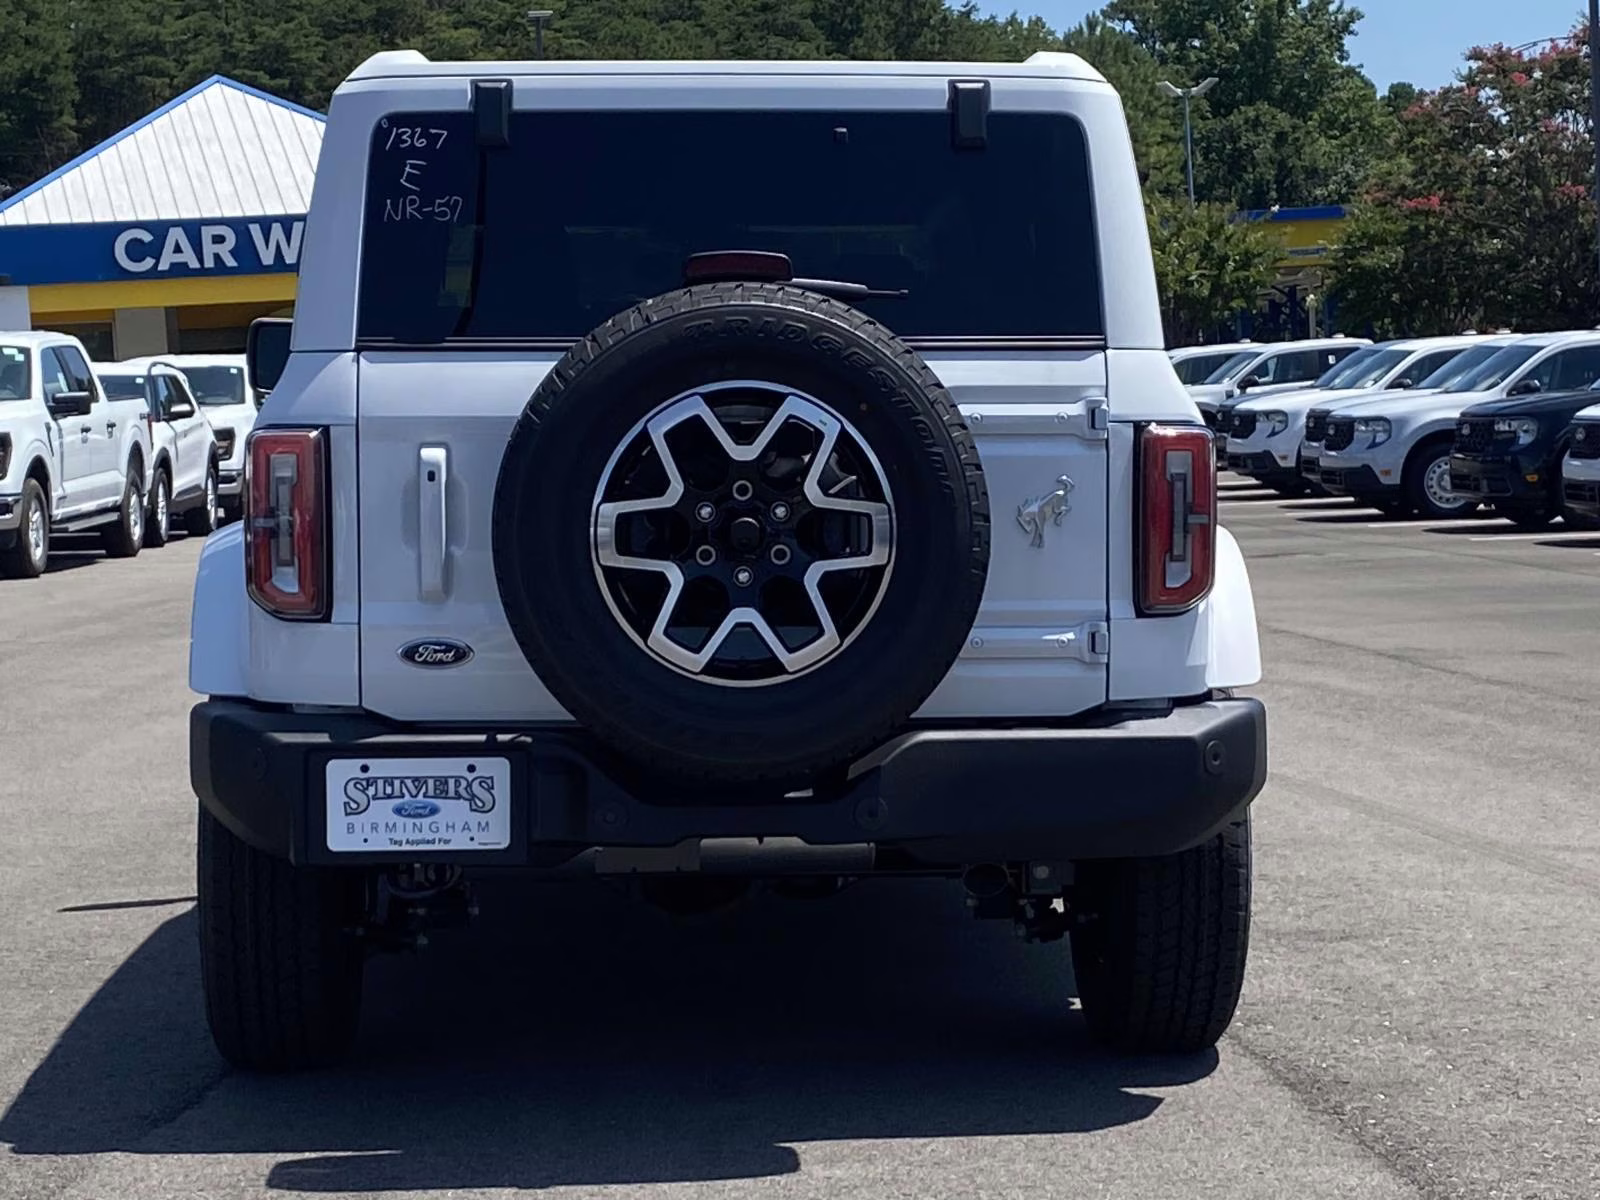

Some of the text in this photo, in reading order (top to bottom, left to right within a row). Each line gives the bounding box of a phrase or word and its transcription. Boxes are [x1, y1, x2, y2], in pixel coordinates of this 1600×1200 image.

[385, 127, 448, 151] 1367
[400, 160, 427, 191] E
[383, 195, 463, 223] NR-57
[114, 224, 239, 273] CAR
[414, 644, 456, 662] Ford
[346, 820, 490, 835] BIRMINGHAM
[388, 837, 452, 847] Tag Applied For
